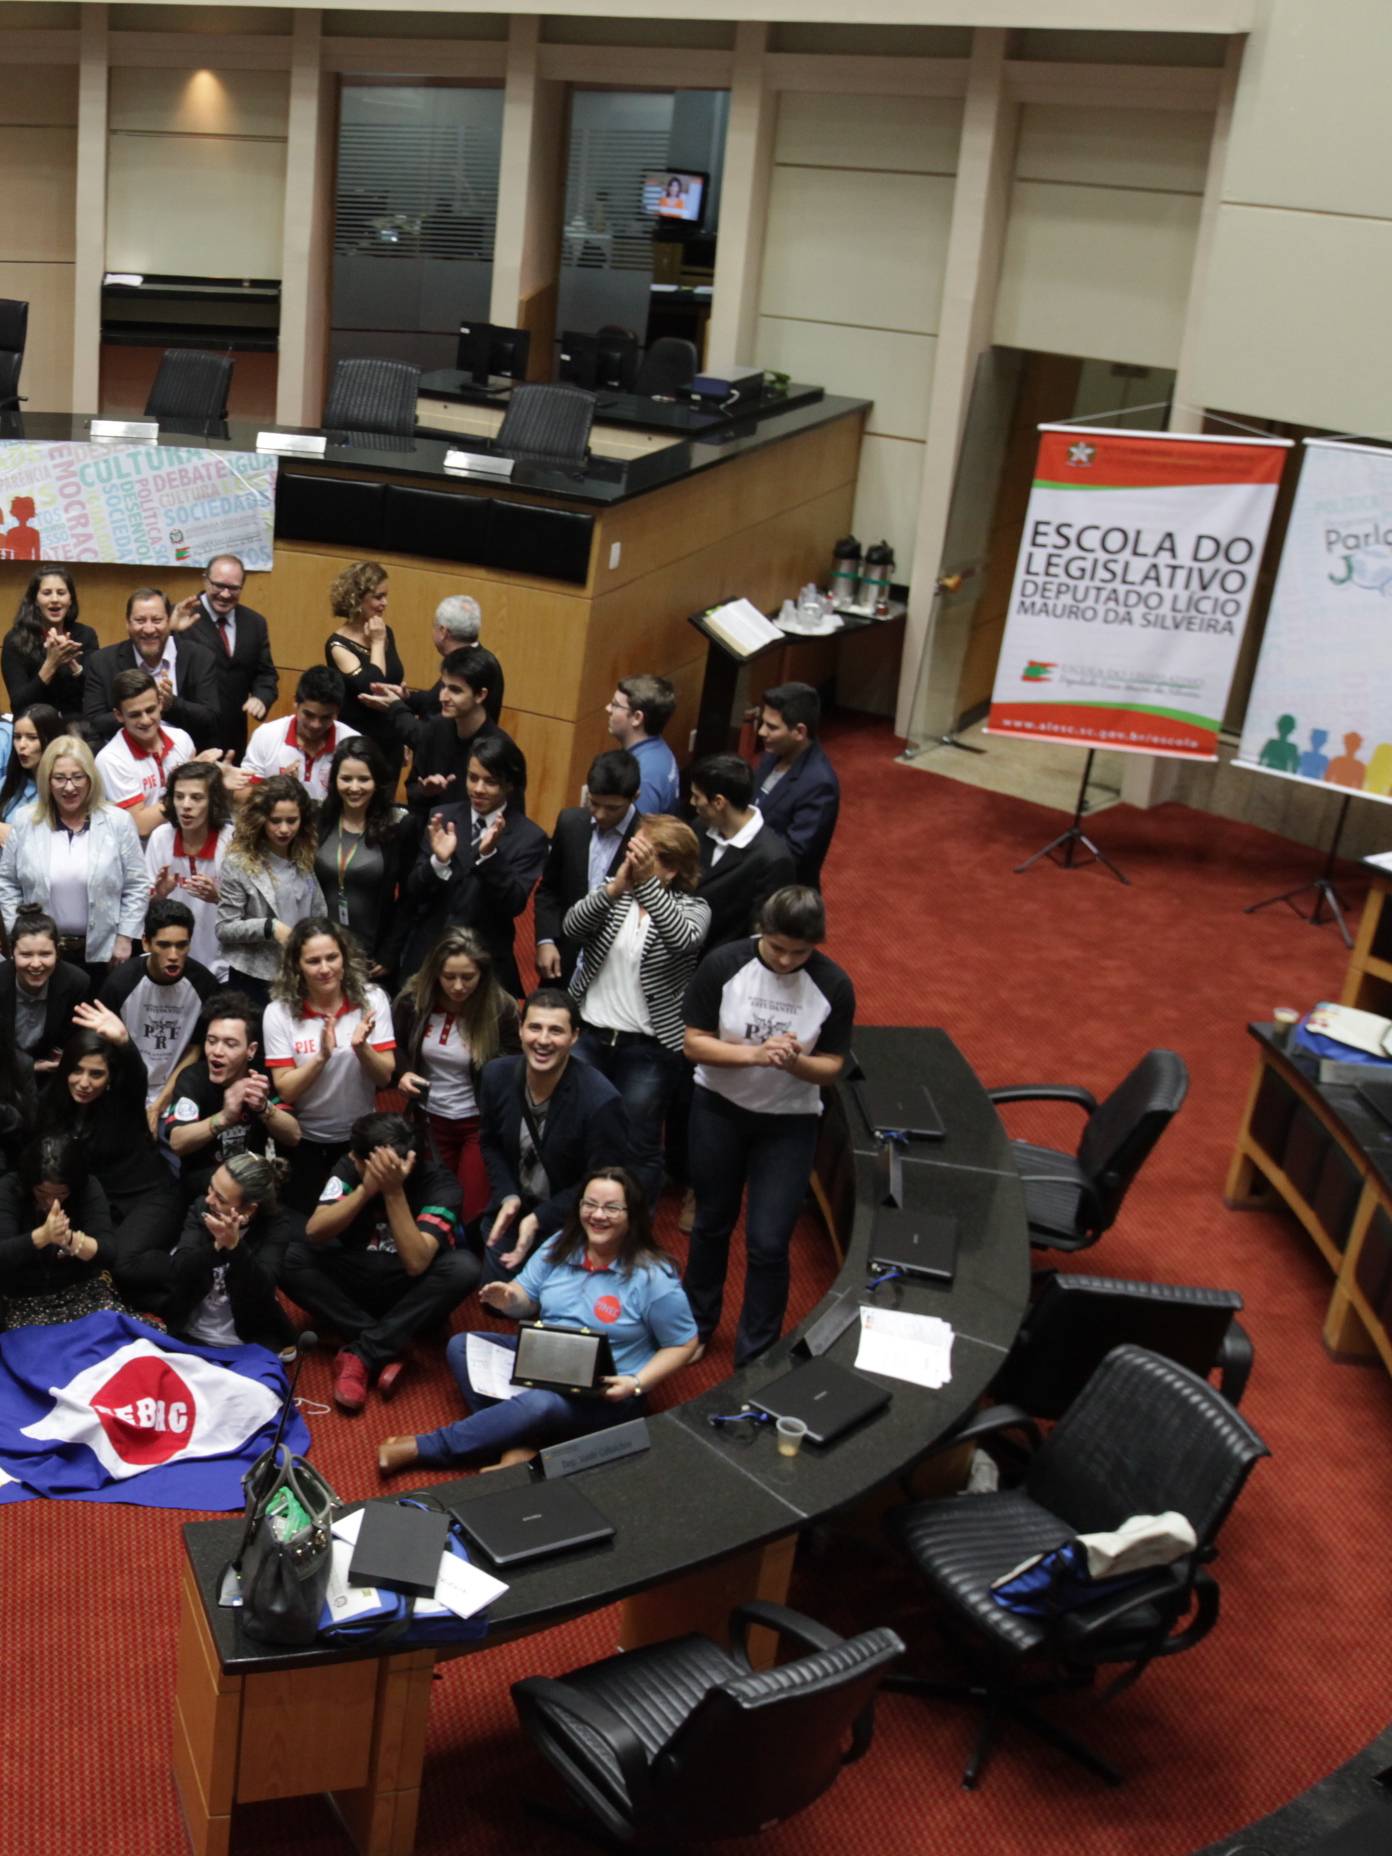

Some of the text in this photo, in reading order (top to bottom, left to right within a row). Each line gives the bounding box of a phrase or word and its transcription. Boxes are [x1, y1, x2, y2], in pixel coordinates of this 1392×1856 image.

[79, 446, 205, 488] CULTURA
[152, 460, 228, 493] DEBATE
[159, 483, 222, 509] CULTURA
[1029, 520, 1255, 565] ESCOLA DO
[1024, 551, 1248, 595] LEGISLATIVO
[1019, 579, 1242, 618] DEPUTADO LÍCIO
[1016, 599, 1236, 637] MAURO DA SILVEIRA
[142, 774, 157, 791] PJE
[295, 1038, 317, 1054] PJE
